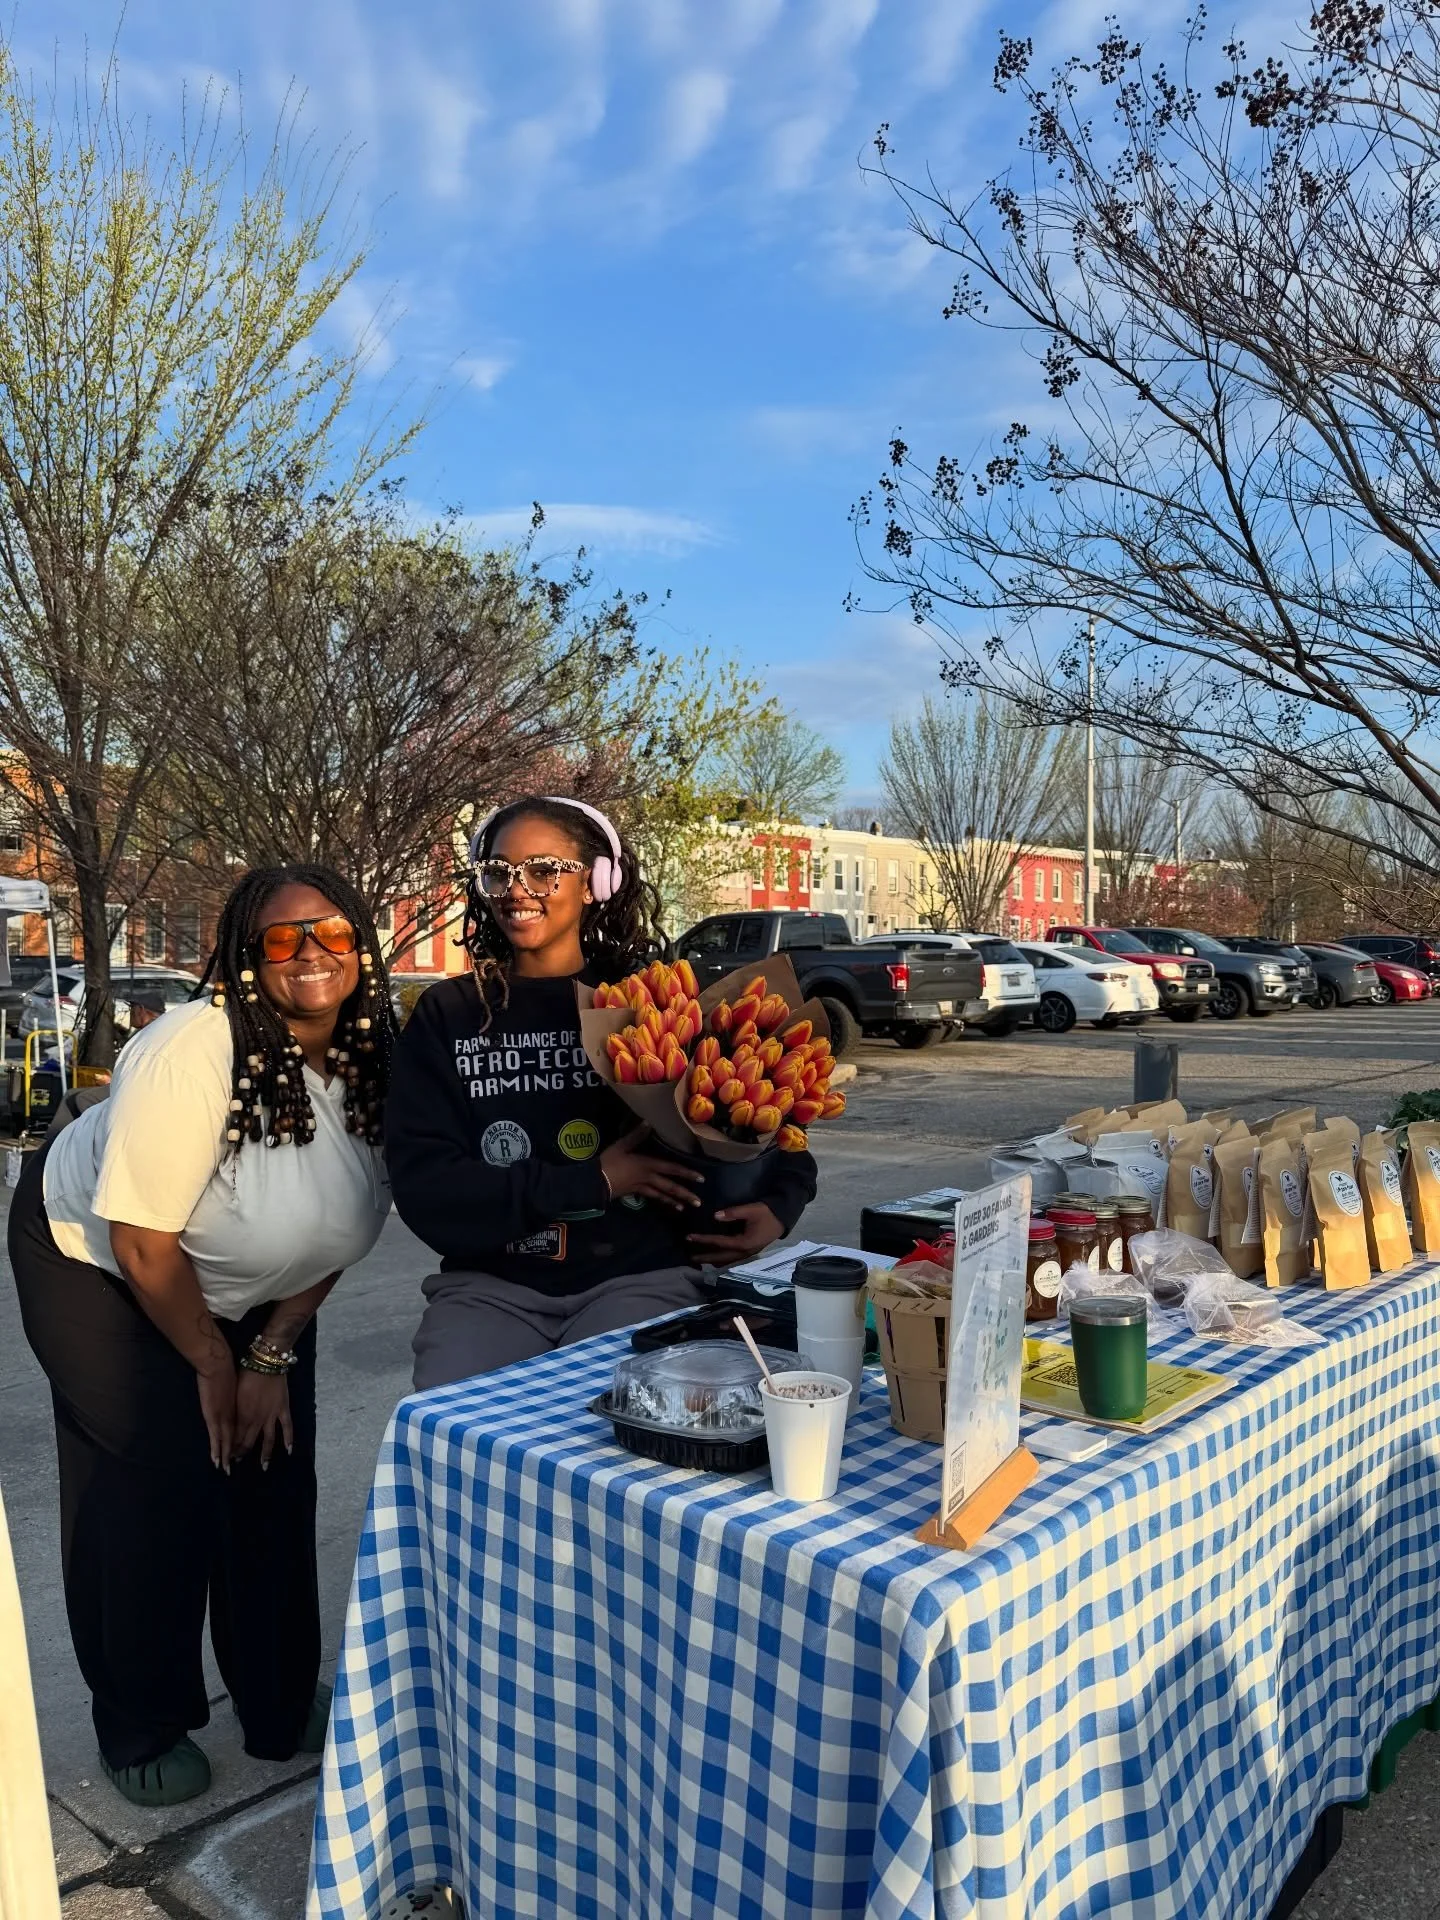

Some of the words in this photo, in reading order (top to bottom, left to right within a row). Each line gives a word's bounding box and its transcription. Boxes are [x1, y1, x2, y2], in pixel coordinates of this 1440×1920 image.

[455, 1035, 491, 1054] FARM
[498, 1031, 557, 1049] LLIANCE
[560, 1030, 577, 1046] OF
[464, 1074, 565, 1098] ARMING
[572, 1070, 608, 1088] SC
[500, 1138, 512, 1157] R
[564, 1132, 595, 1149] OKRA
[963, 1209, 982, 1231] OVER
[982, 1204, 991, 1221] 30
[961, 1235, 968, 1250] &
[968, 1220, 1000, 1247] GARDENS
